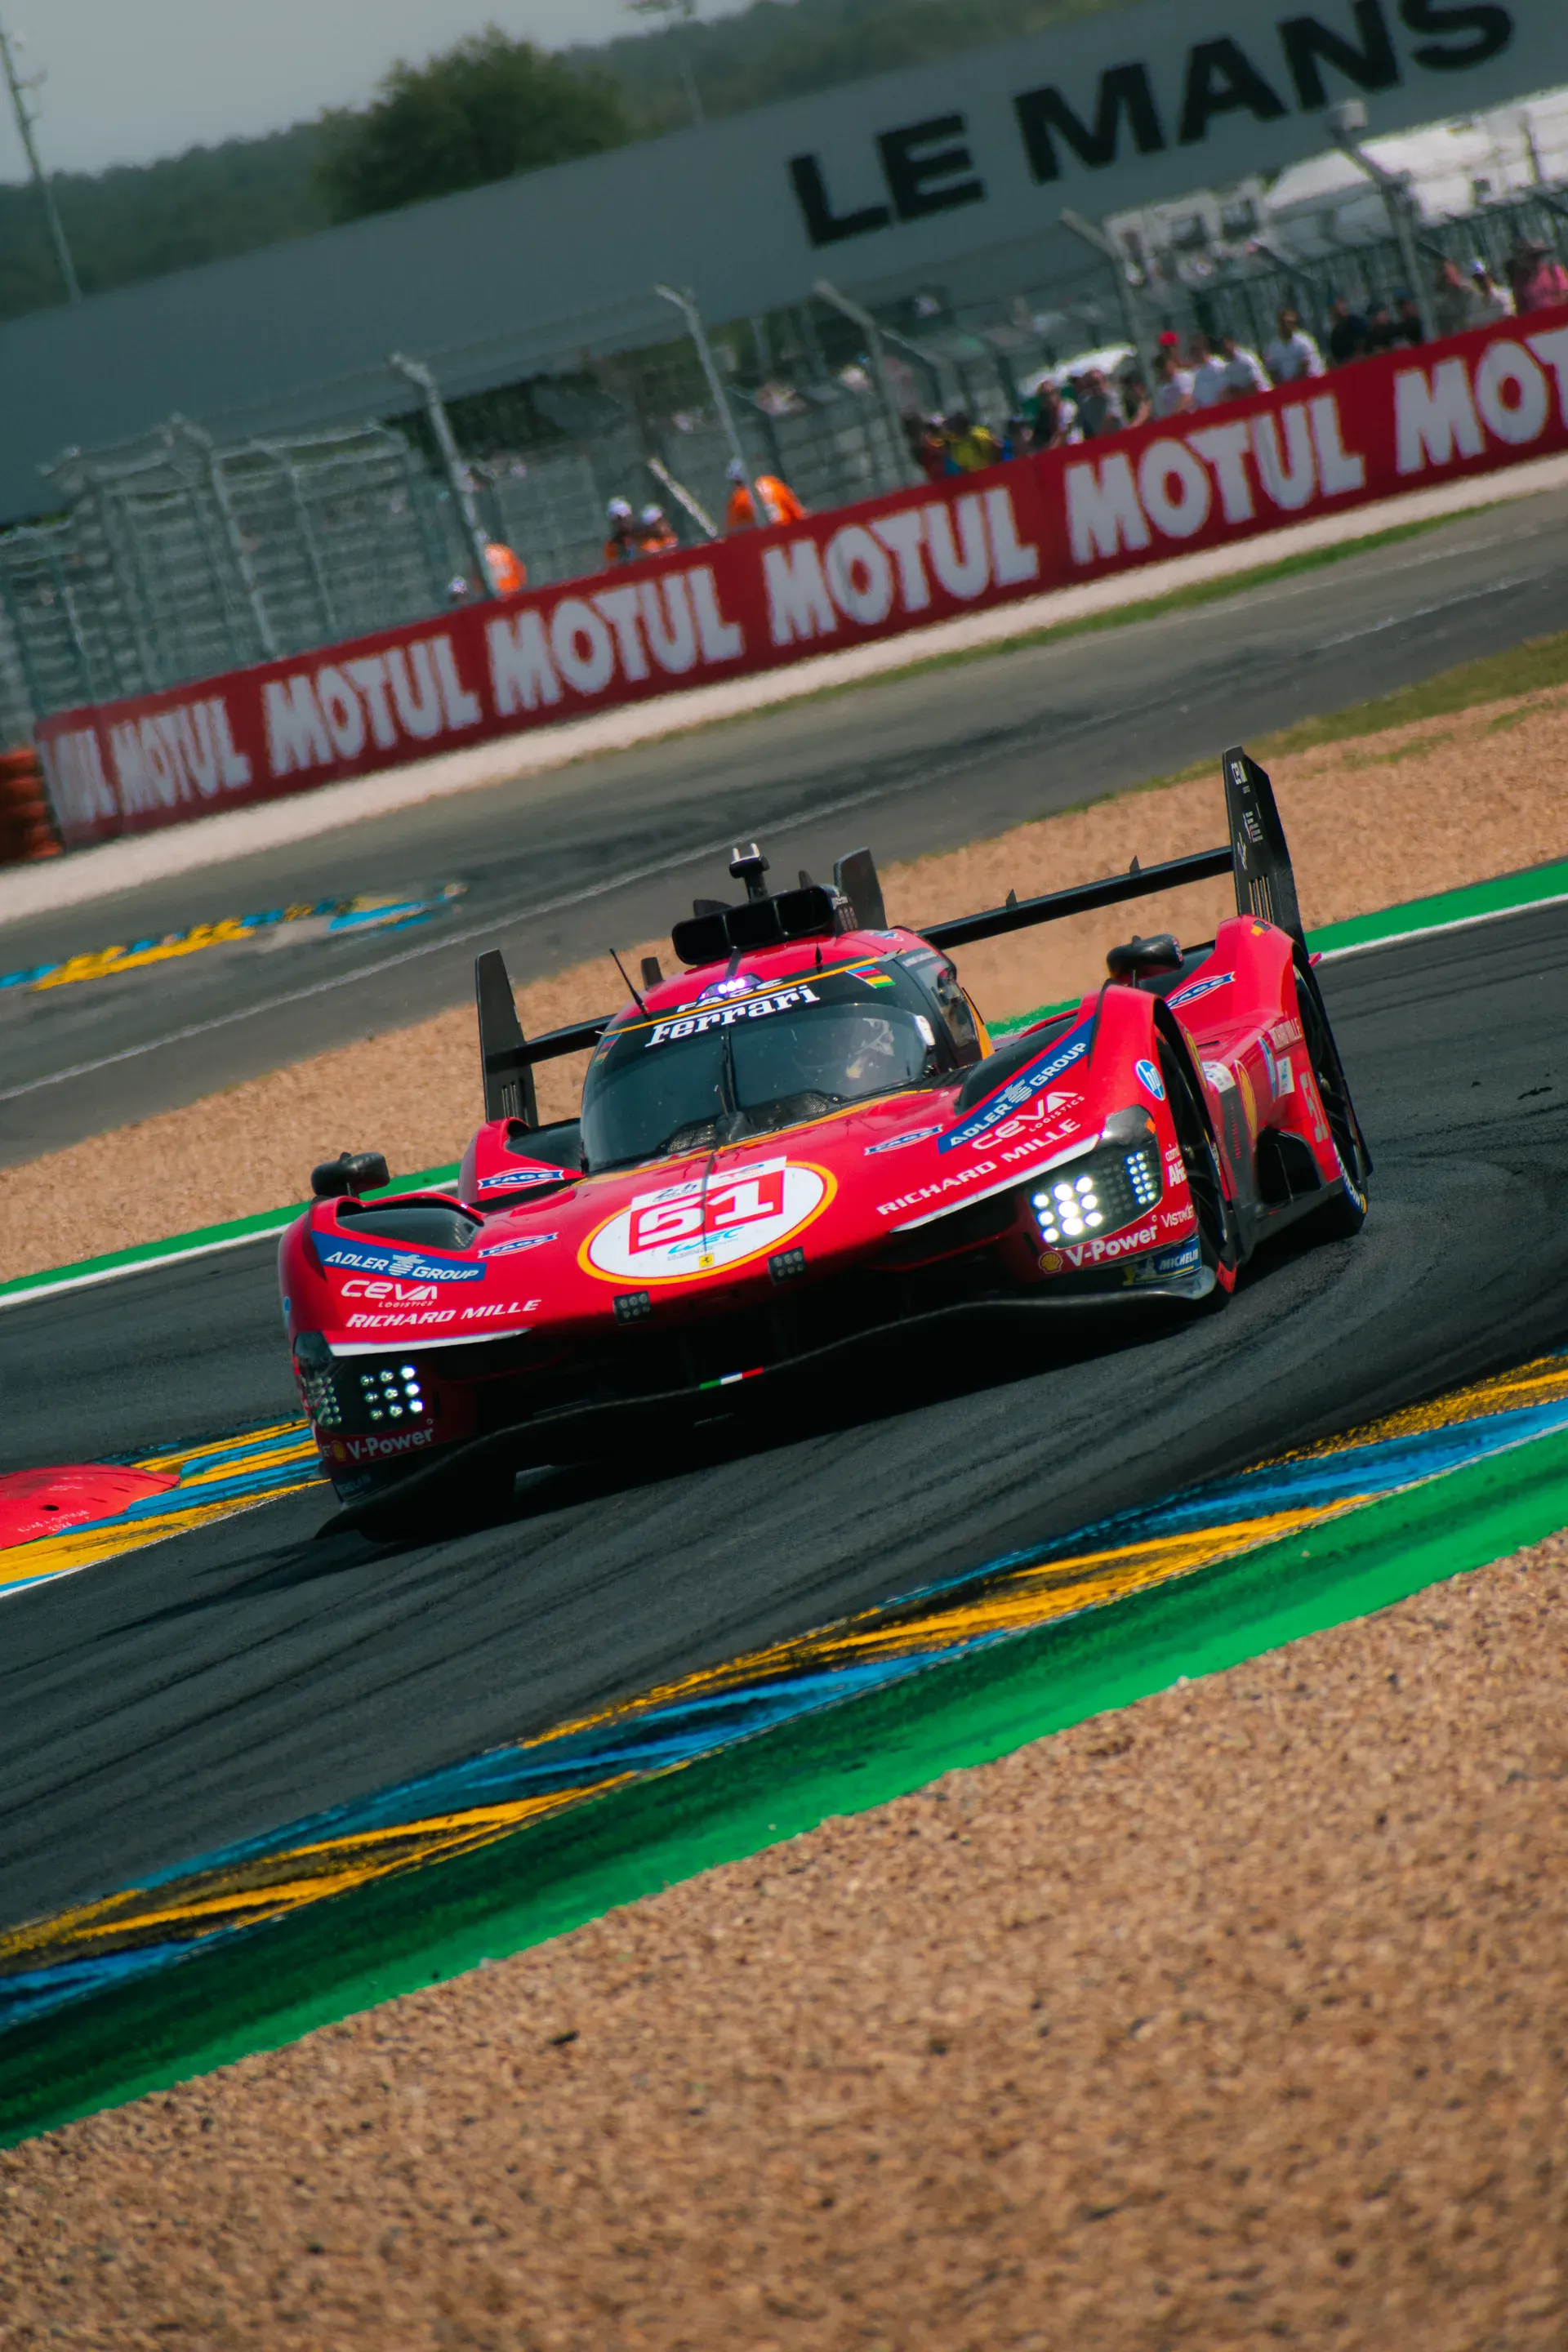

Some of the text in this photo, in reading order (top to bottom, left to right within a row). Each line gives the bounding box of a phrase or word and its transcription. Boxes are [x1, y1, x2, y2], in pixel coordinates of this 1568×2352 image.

[786, 0, 1513, 247] LE MANS
[1063, 392, 1365, 565] MOTUL
[763, 487, 1039, 647] MOTUL
[485, 564, 744, 719] MOTUL
[262, 635, 480, 776] MOTUL
[109, 694, 252, 817] MOTUL
[644, 984, 821, 1048] Ferrari
[950, 1042, 1087, 1147] ADLER GROUP
[1138, 1062, 1163, 1099] hp
[972, 1091, 1079, 1151] CEVA
[1028, 1095, 1085, 1132] LOGISTICS
[875, 1117, 1081, 1215] RICHARD MILLE
[638, 1179, 774, 1247] 51
[324, 1251, 479, 1281] ADLER GROUP
[1064, 1225, 1158, 1267] V-Power
[1160, 1247, 1199, 1271] MICHELIN
[341, 1280, 438, 1301] CEVA
[345, 1298, 542, 1328] RICHARD MILLE
[377, 1300, 434, 1308] LOGISTICS
[346, 1428, 434, 1460] V-Power
